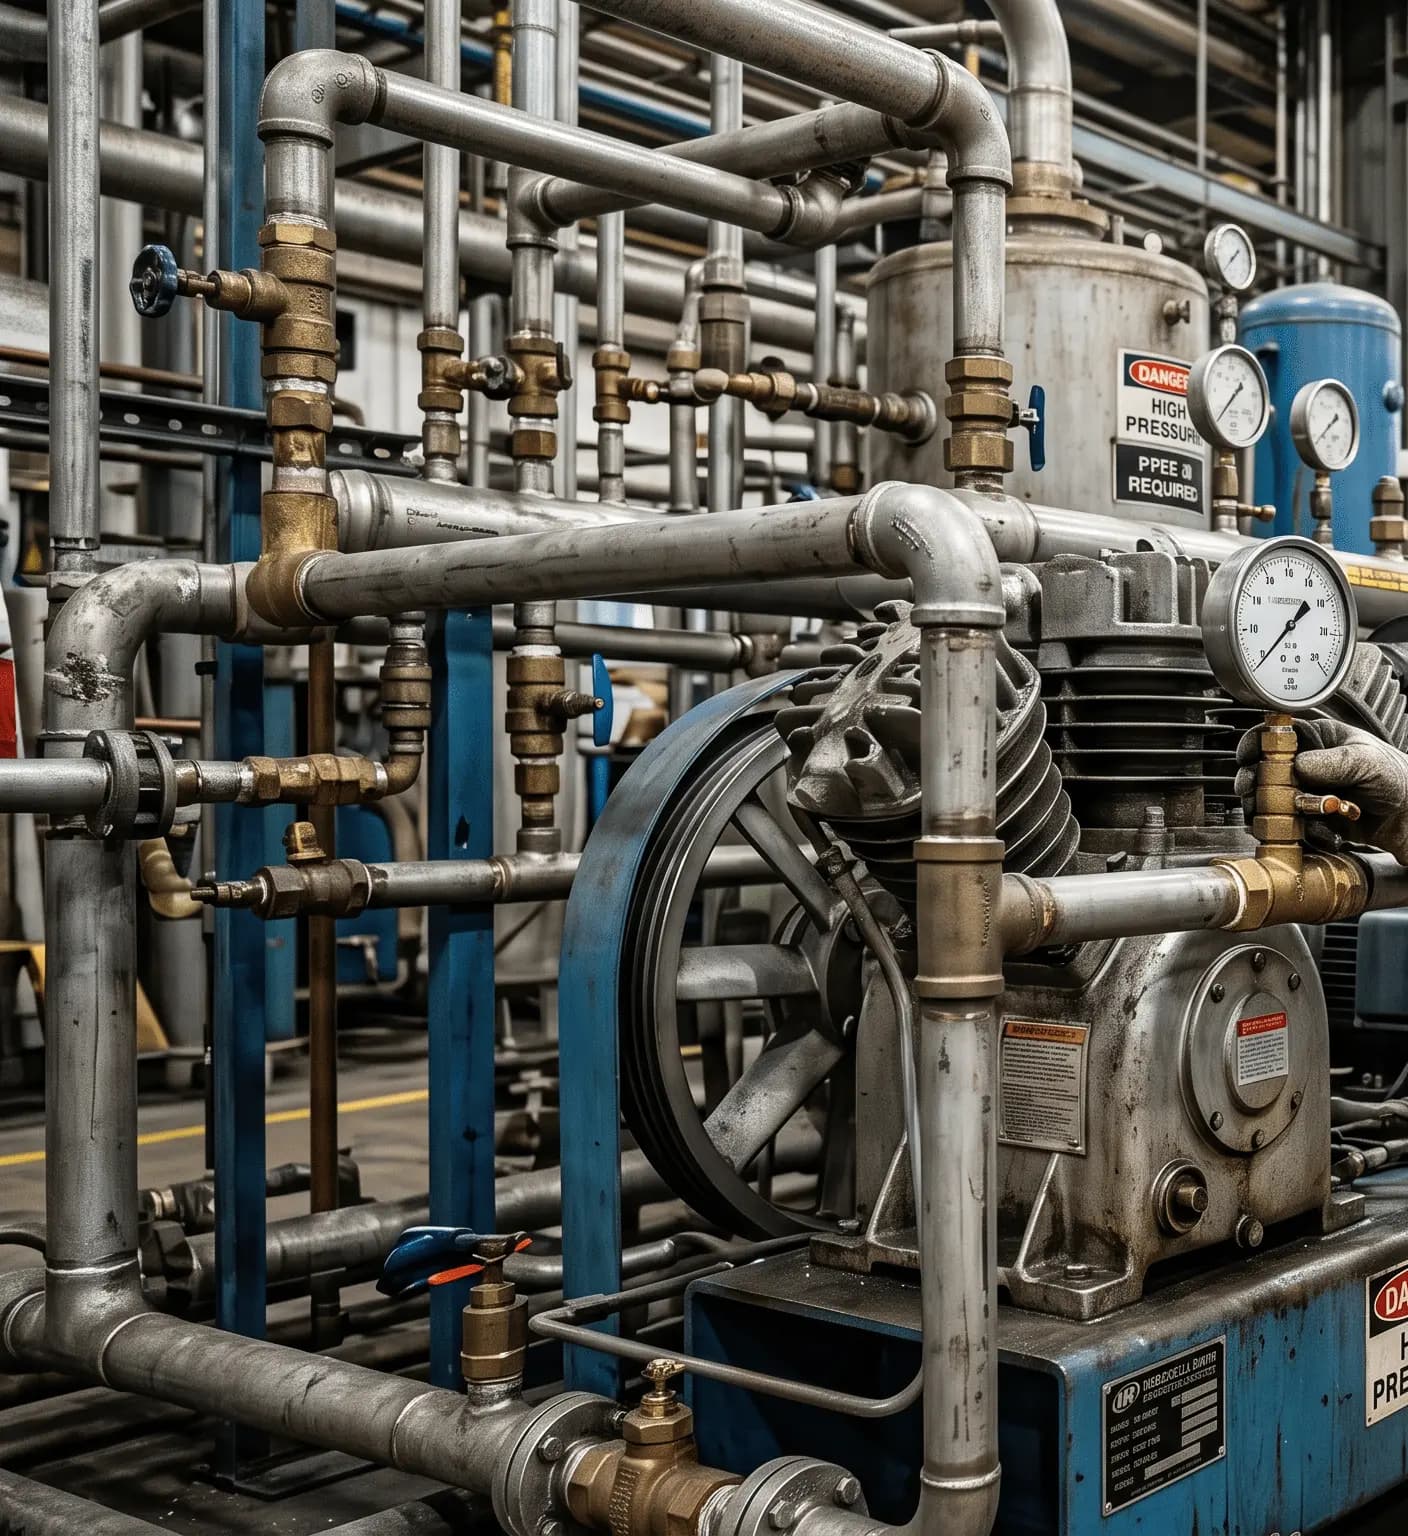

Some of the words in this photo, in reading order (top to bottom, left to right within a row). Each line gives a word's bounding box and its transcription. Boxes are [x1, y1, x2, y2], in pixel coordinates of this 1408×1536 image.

[1152, 398, 1186, 420] HIGH
[1138, 455, 1178, 477] PPEE
[1128, 475, 1198, 503] REQUIRED
